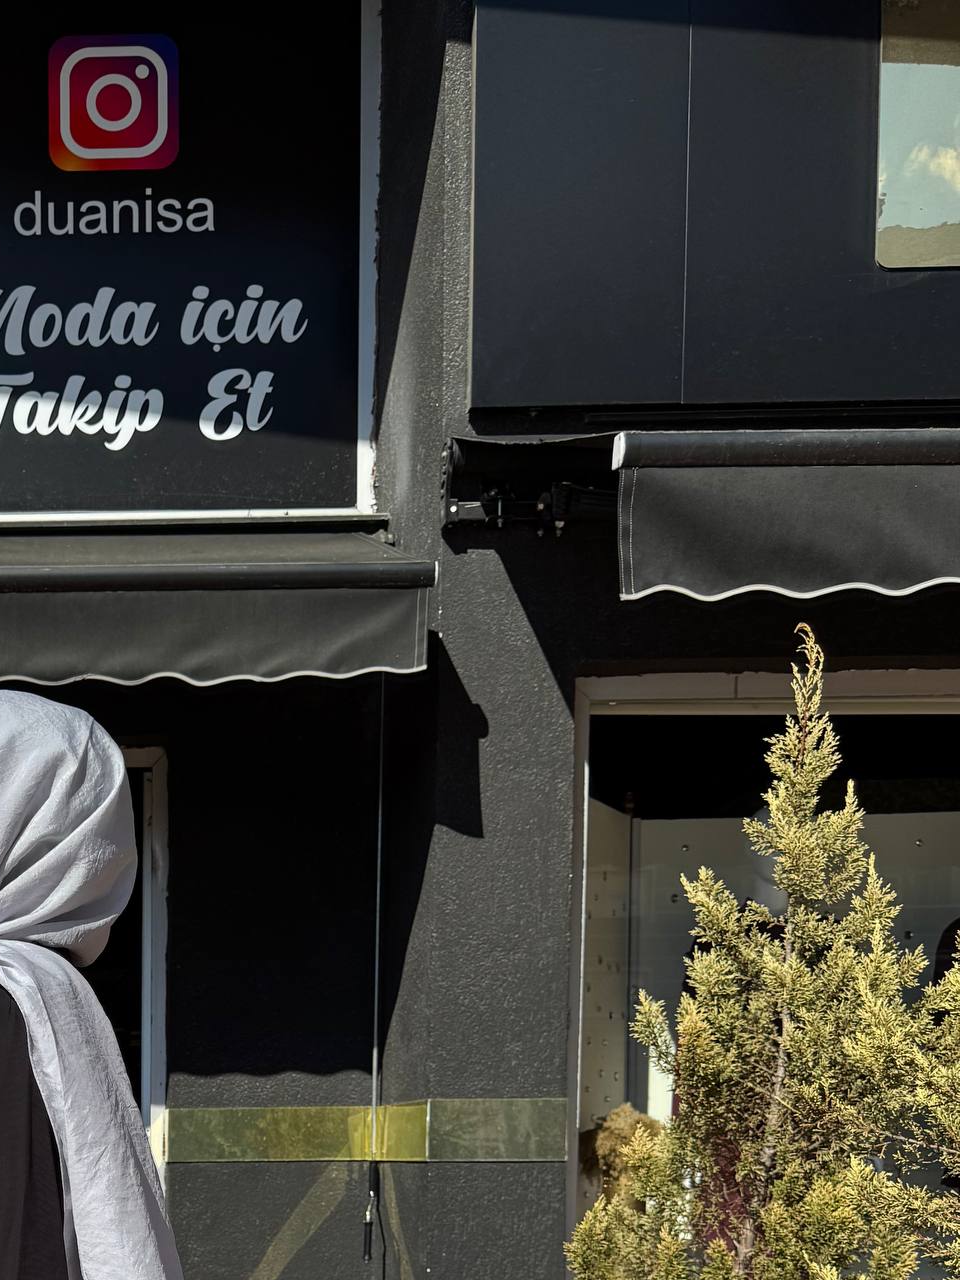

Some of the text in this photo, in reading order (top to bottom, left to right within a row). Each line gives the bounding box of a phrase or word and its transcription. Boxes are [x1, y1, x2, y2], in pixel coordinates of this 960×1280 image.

[13, 188, 215, 236] duanisa
[180, 284, 308, 352] için
[198, 368, 275, 440] Et
